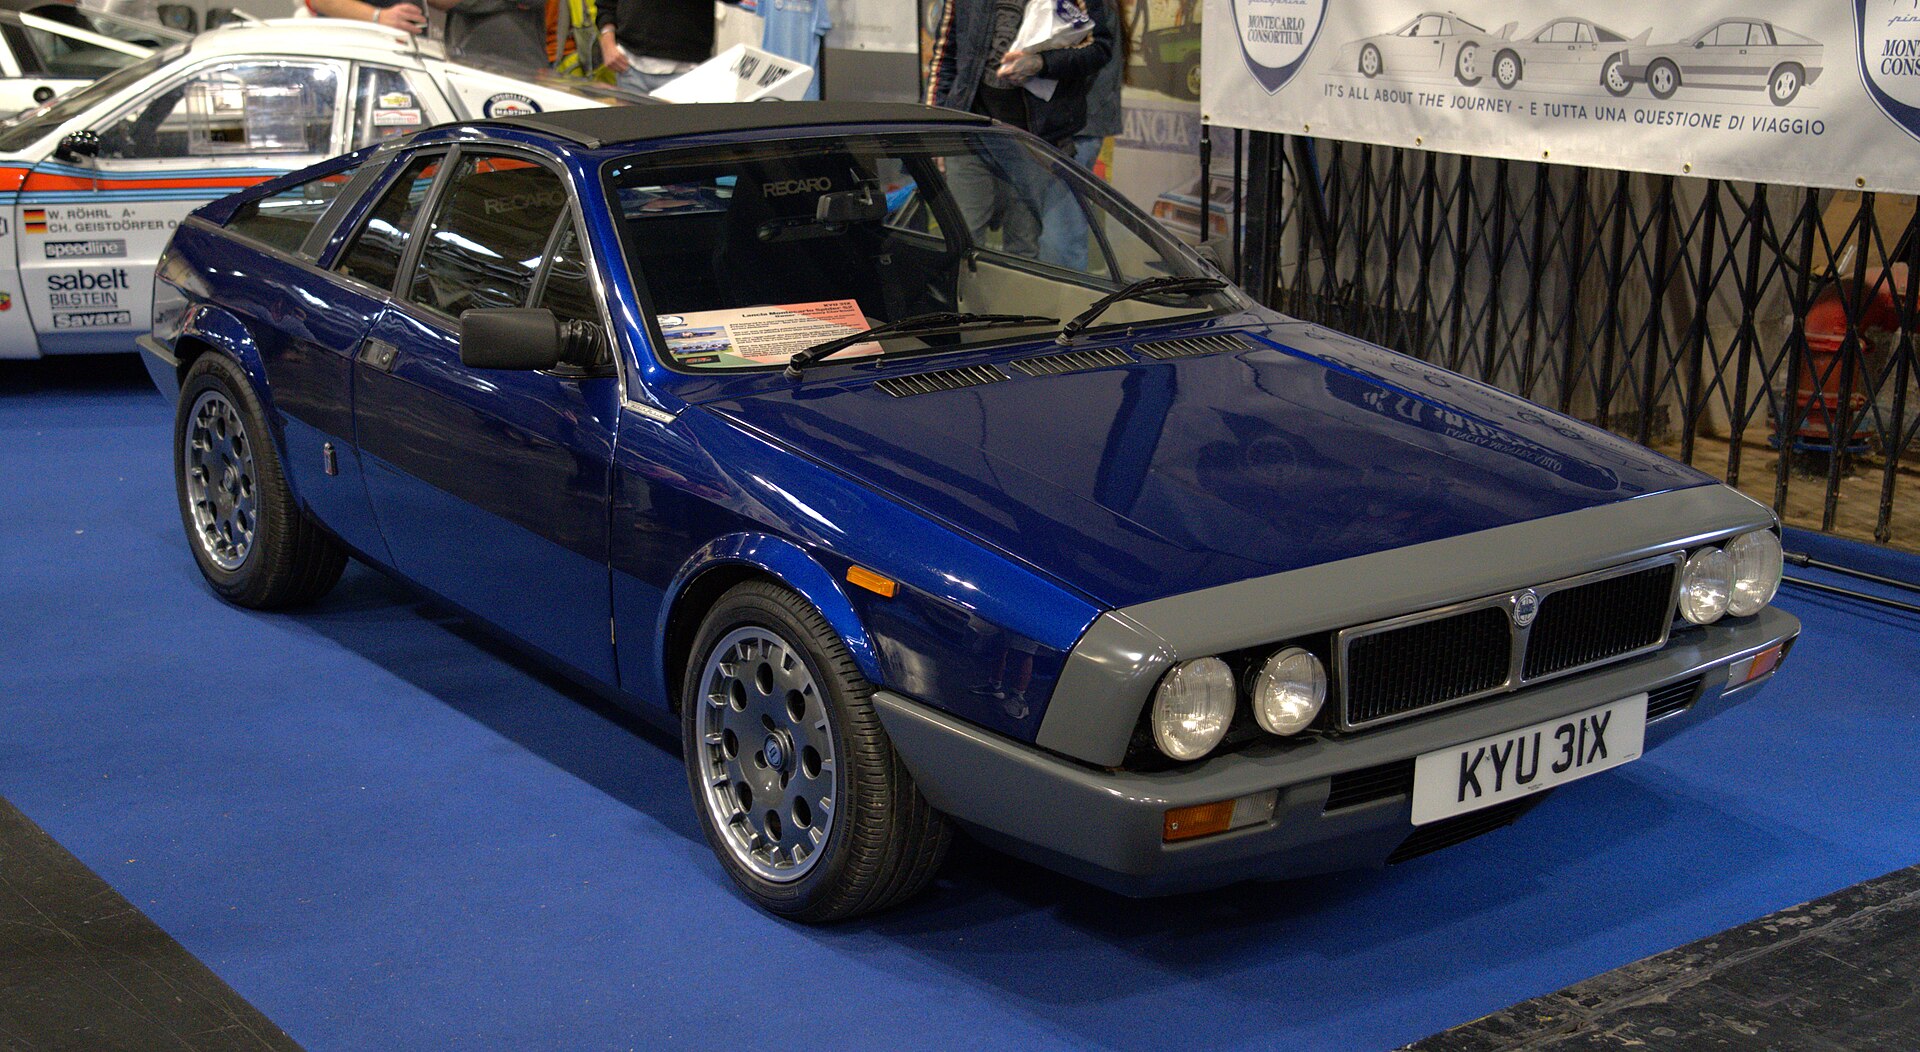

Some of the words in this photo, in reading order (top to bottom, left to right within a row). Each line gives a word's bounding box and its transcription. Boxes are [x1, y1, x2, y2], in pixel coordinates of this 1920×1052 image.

[1248, 15, 1305, 31] MONTECARLO
[1247, 29, 1303, 45] CONSORTIUM
[1881, 39, 1920, 57] MON
[1324, 83, 1344, 98] IT'S
[1349, 86, 1369, 101] ALL
[1374, 88, 1413, 105] ABOUT
[1418, 93, 1445, 108] THE
[1450, 95, 1512, 114] JOURNEY
[1530, 102, 1537, 116] E
[1543, 103, 1588, 120] TUTTA
[1595, 106, 1627, 123] UNA
[1633, 109, 1722, 130] QUESTIONE
[1728, 115, 1745, 131] DI
[1752, 116, 1825, 137] VIAGGIO
[1114, 110, 1190, 146] ANCIA
[763, 176, 832, 198] RECARO
[484, 191, 567, 215] RECARO
[48, 210, 64, 220] W.
[67, 208, 112, 221] RÖHRL
[49, 223, 72, 234] CH.
[74, 218, 165, 233] GEISTDÖRFER
[46, 241, 120, 258] speedline
[48, 269, 129, 290] sabelt
[49, 291, 118, 305] BILSTEIN
[56, 312, 130, 328] Savara
[1458, 731, 1541, 803] KYU
[1551, 709, 1612, 774] 31X
